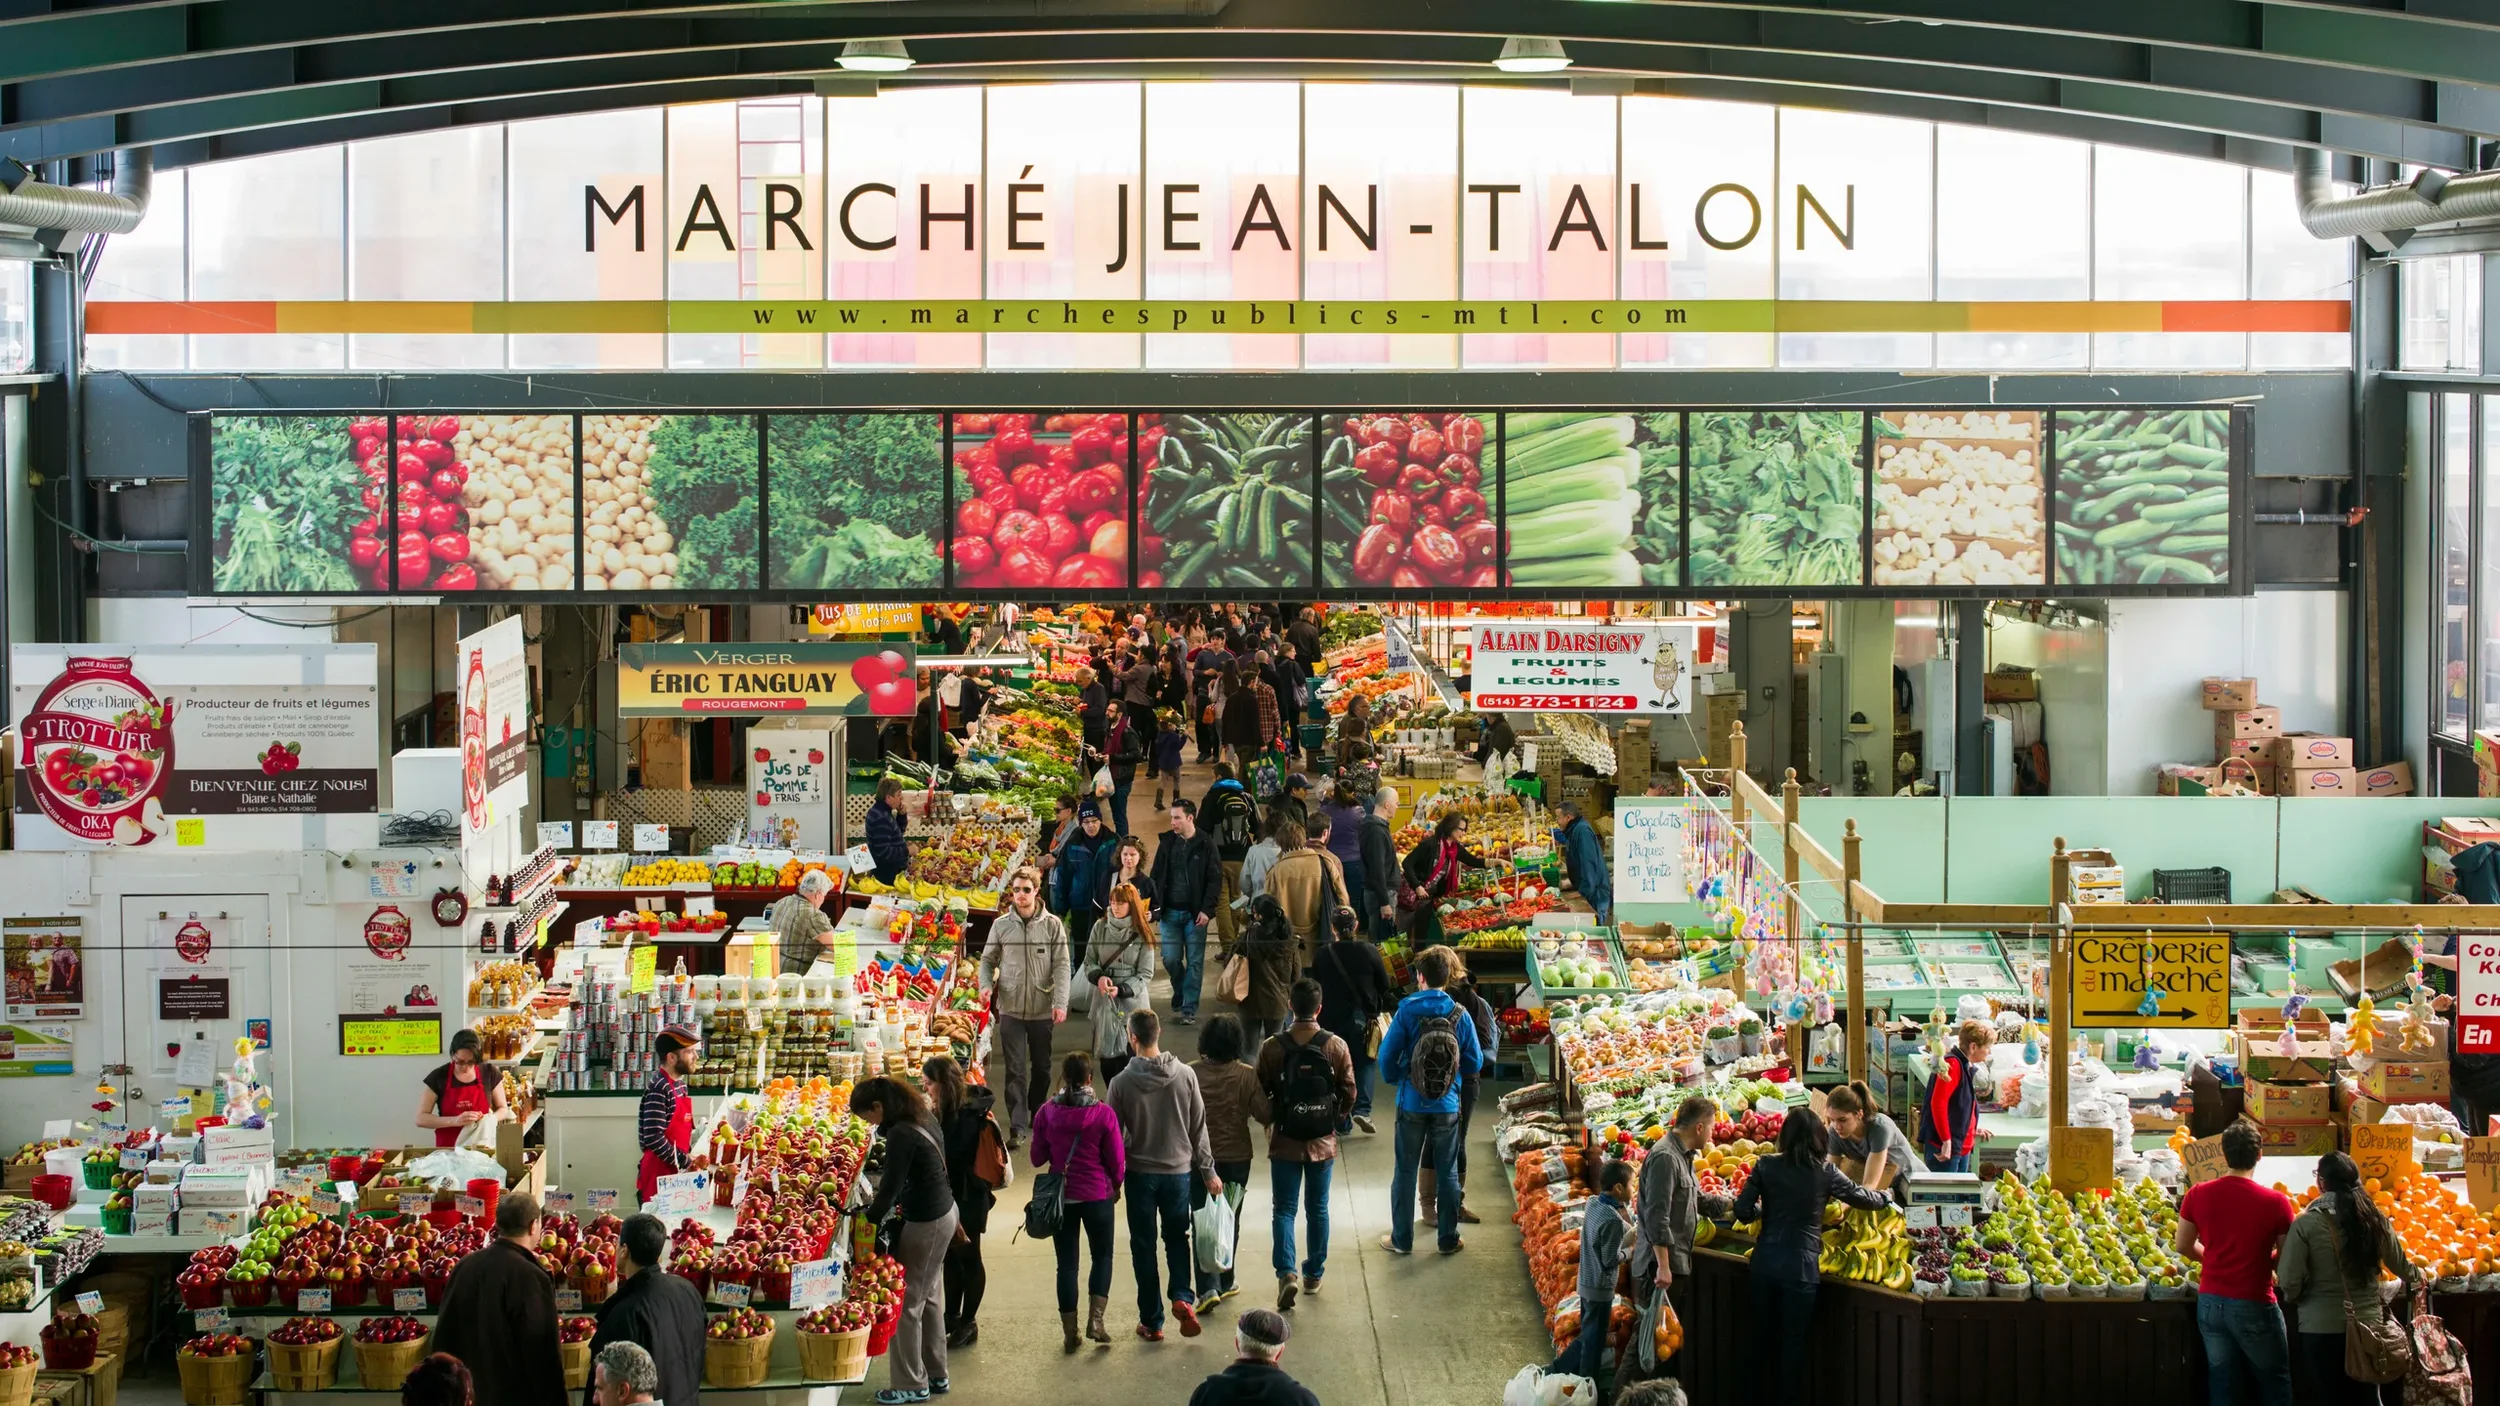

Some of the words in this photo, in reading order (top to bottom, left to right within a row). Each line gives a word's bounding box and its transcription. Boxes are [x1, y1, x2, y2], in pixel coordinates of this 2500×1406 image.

[585, 164, 1046, 253] MARCHÉ
[1106, 182, 1855, 274] JEAN-TALON
[753, 303, 1688, 331] www.marchespublics-mtl.com
[819, 605, 841, 622] JUS
[845, 604, 861, 617] DE
[861, 615, 890, 630] 100%
[893, 612, 914, 625] PUR
[1479, 628, 1540, 653] ALAIN
[1545, 629, 1646, 654] DARSIGNY
[693, 650, 797, 666] VERGER
[1511, 658, 1608, 668] FRUITS
[1550, 667, 1568, 676] &
[650, 669, 710, 694] ÉRIC
[718, 672, 838, 694] TANGUAY
[1497, 676, 1621, 687] LÉGUMES
[63, 695, 98, 711] Serge
[105, 695, 140, 709] Diane
[185, 699, 250, 709] Producteur
[254, 699, 269, 709] de
[272, 699, 303, 709] fruits
[306, 700, 318, 709] et
[321, 699, 371, 712] légumes
[702, 700, 787, 709] ROUGEMONT
[1482, 697, 1516, 708] (514)
[1519, 696, 1627, 709] 273-1124
[204, 714, 225, 722] Fruits
[226, 714, 242, 722] frais
[252, 714, 276, 722] saison
[282, 714, 297, 722] Miel
[303, 714, 323, 723] Sirop
[323, 714, 352, 722] d'érable
[207, 722, 237, 730] Produits
[237, 722, 266, 730] d'érable
[308, 722, 350, 731] canneberge
[39, 718, 155, 753] TROTTIER
[764, 758, 792, 776] JUS
[797, 765, 812, 776] DE
[190, 779, 277, 793] BIENVENUE
[280, 780, 319, 792] CHEZ
[323, 778, 368, 791] NOUS!
[762, 777, 808, 793] POMME
[241, 793, 270, 805] Diane
[277, 792, 317, 804] Nathalie
[774, 793, 801, 803] FRAIS
[38, 792, 61, 825] PRODUCTEUR
[65, 821, 82, 835] FRUITS
[1623, 809, 1682, 829] Chocolats
[80, 815, 111, 830] OKA
[1643, 828, 1658, 843] de
[1625, 840, 1665, 865] Pâques
[1627, 865, 1641, 878] en
[1645, 861, 1672, 878] vente
[1641, 878, 1656, 892] ici
[2078, 936, 2225, 977] Crêperie
[2080, 969, 2096, 993] du
[2099, 965, 2224, 993] marché
[2463, 1024, 2493, 1045] En
[2386, 1065, 2411, 1077] Dole
[2266, 1089, 2290, 1099] Dole
[2257, 1127, 2297, 1144] Dole
[2356, 1126, 2409, 1159] Orange
